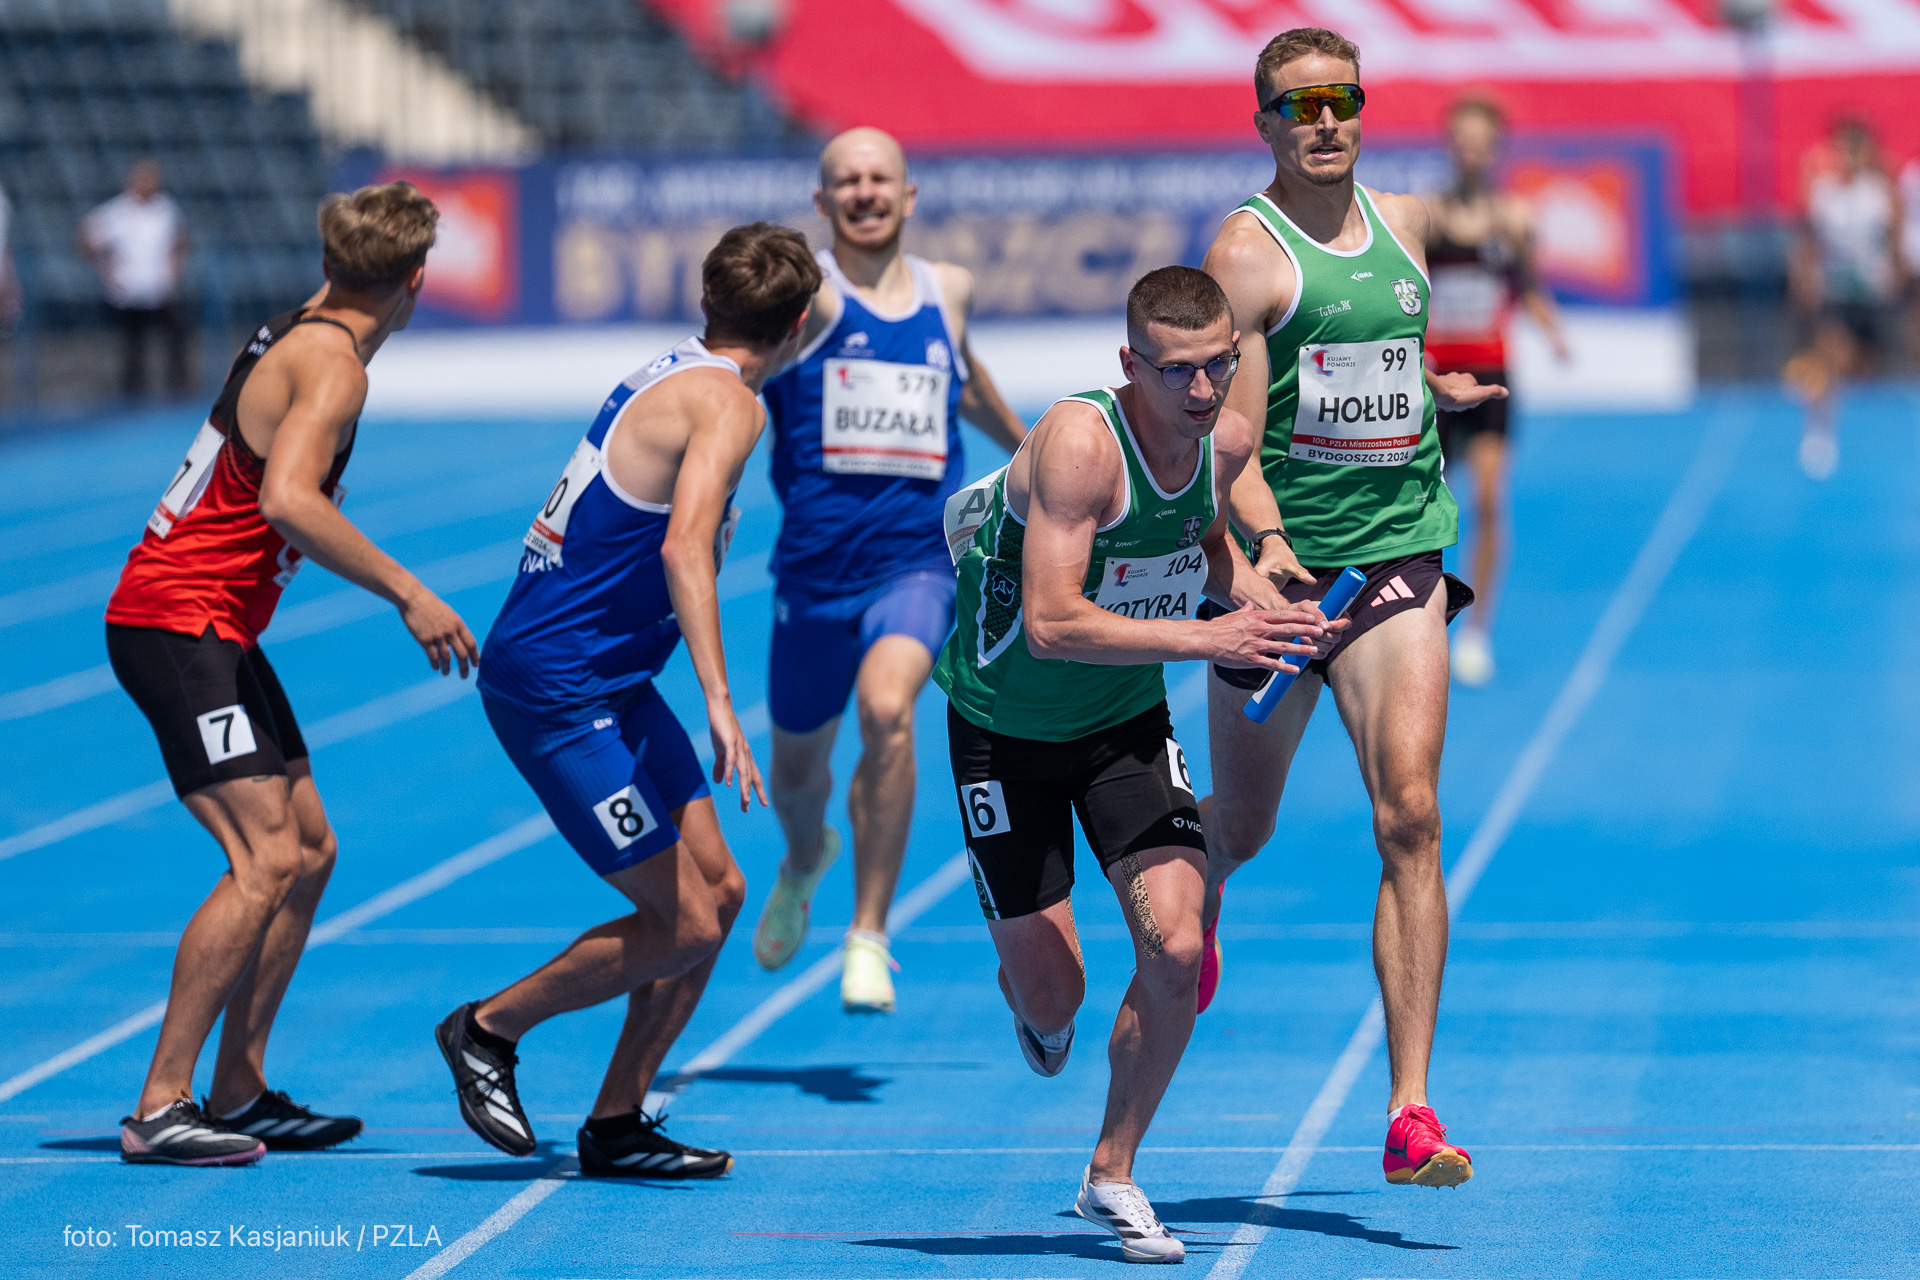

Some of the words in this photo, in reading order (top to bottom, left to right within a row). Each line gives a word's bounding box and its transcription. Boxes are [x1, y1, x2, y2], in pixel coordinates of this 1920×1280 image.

[1381, 346, 1407, 373] 99
[835, 406, 938, 438] BUZAŁA
[1317, 392, 1410, 424] HOŁUB
[1307, 449, 1385, 463] BYDGOSZCZ
[1387, 451, 1409, 462] 2024
[1312, 437, 1328, 445] 100.
[1329, 440, 1348, 448] PZLA
[1349, 439, 1392, 448] Mistrzostwa
[1393, 437, 1410, 446] Polski
[1163, 552, 1203, 578] 104
[209, 712, 235, 753] 7
[1177, 748, 1192, 788] 6
[609, 797, 644, 838] 8
[969, 787, 996, 832] 6
